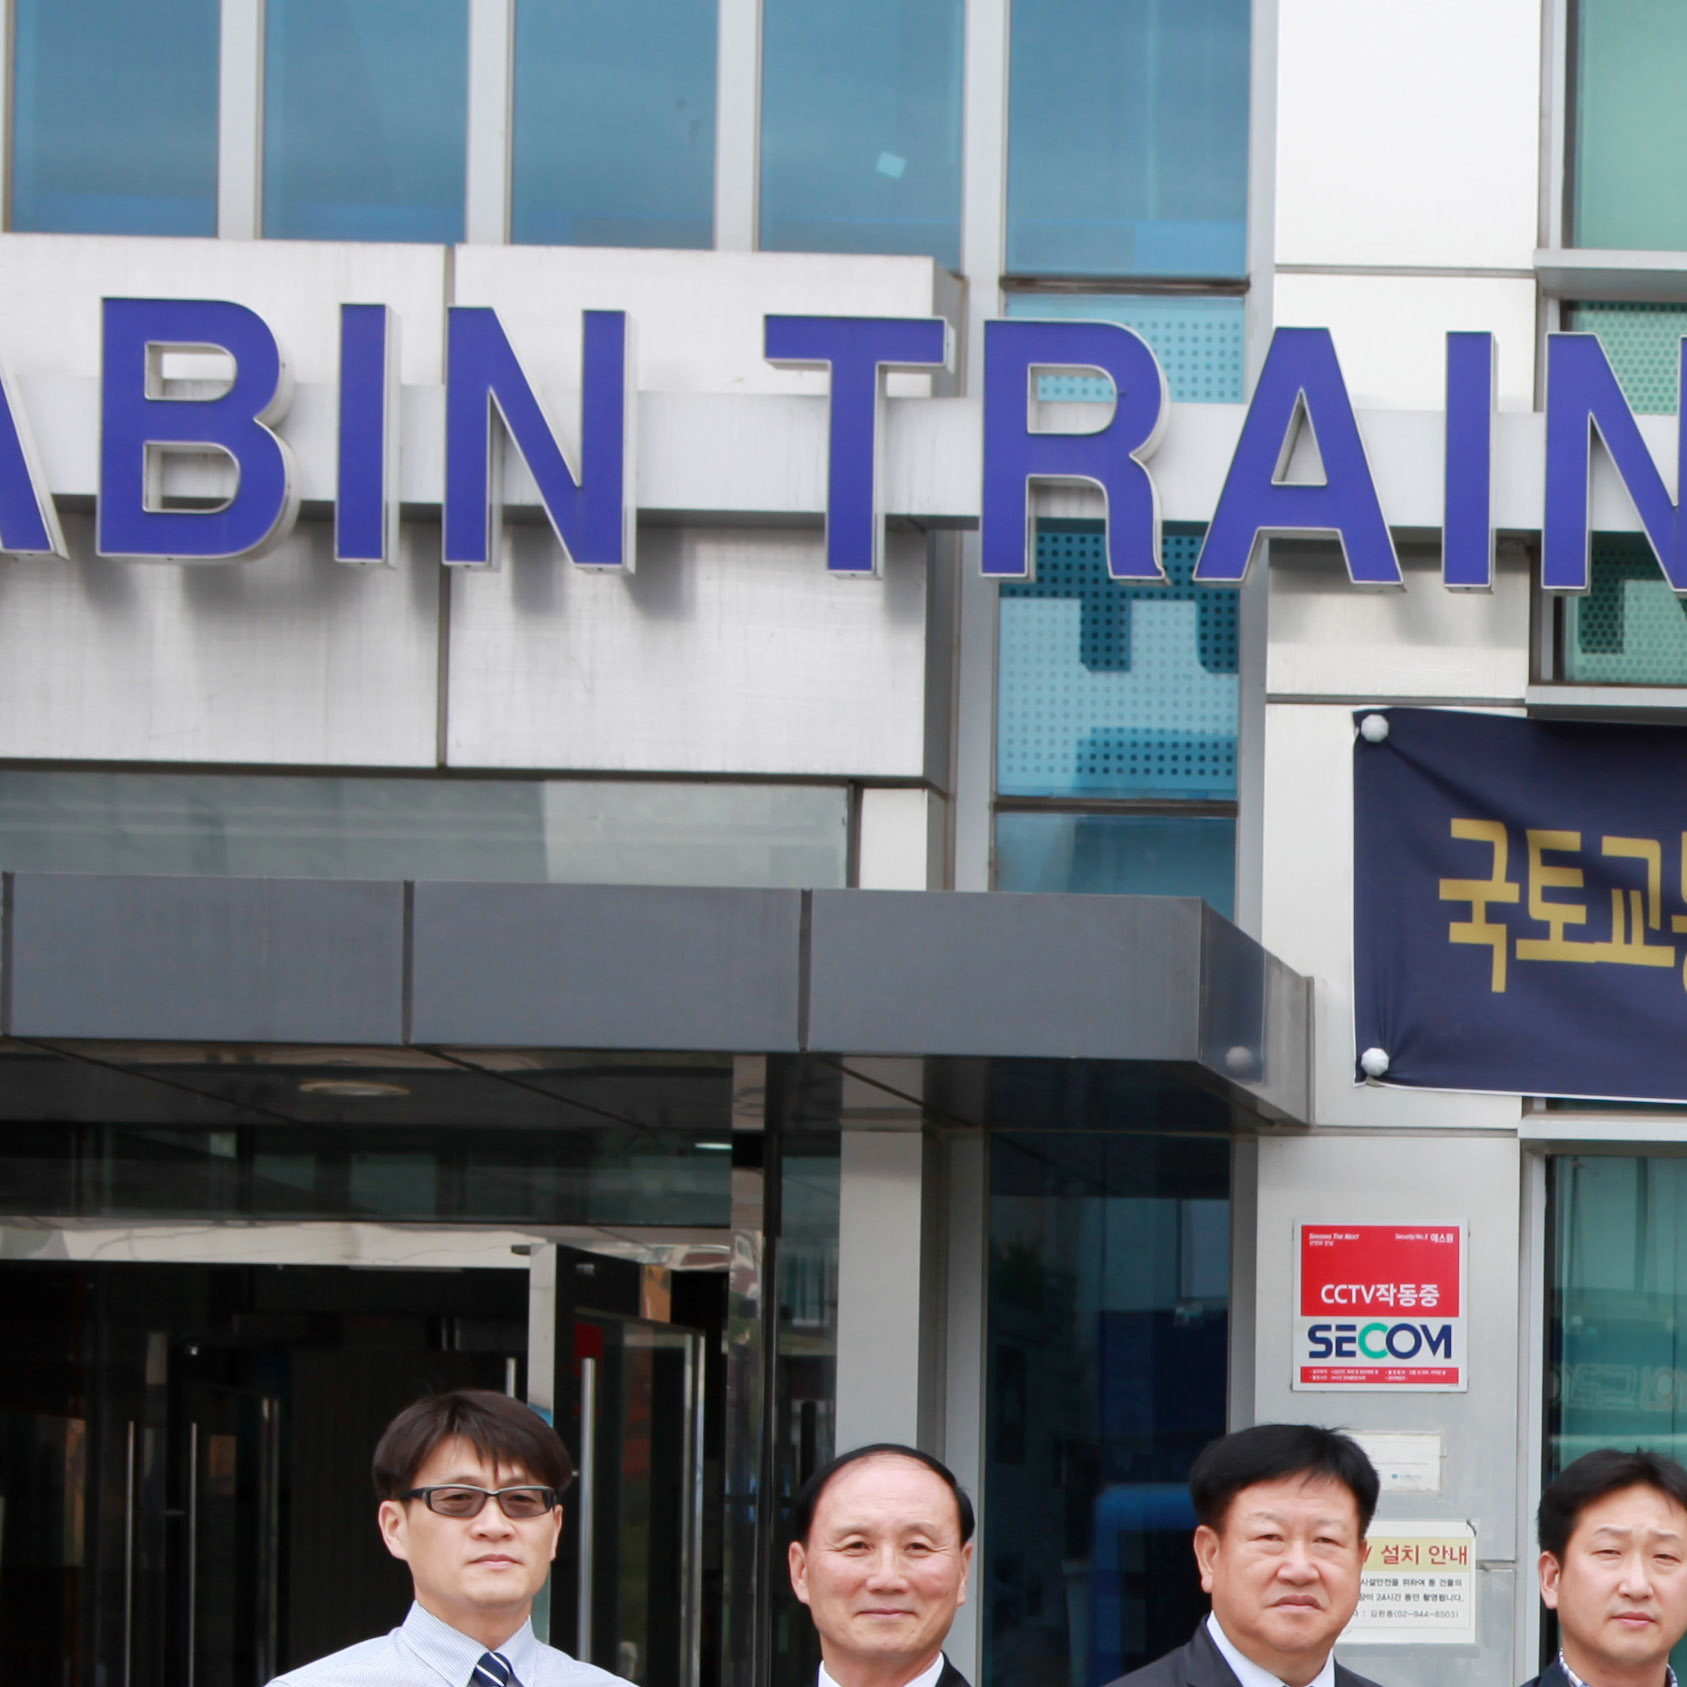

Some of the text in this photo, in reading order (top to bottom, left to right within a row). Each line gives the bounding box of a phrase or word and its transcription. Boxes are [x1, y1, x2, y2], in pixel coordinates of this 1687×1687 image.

[0, 297, 628, 566] BIN
[1321, 1283, 1440, 1307] CCTV작동중
[1307, 1322, 1452, 1359] SECOM
[1381, 1545, 1419, 1566] 설치
[1428, 1545, 1467, 1566] 안내
